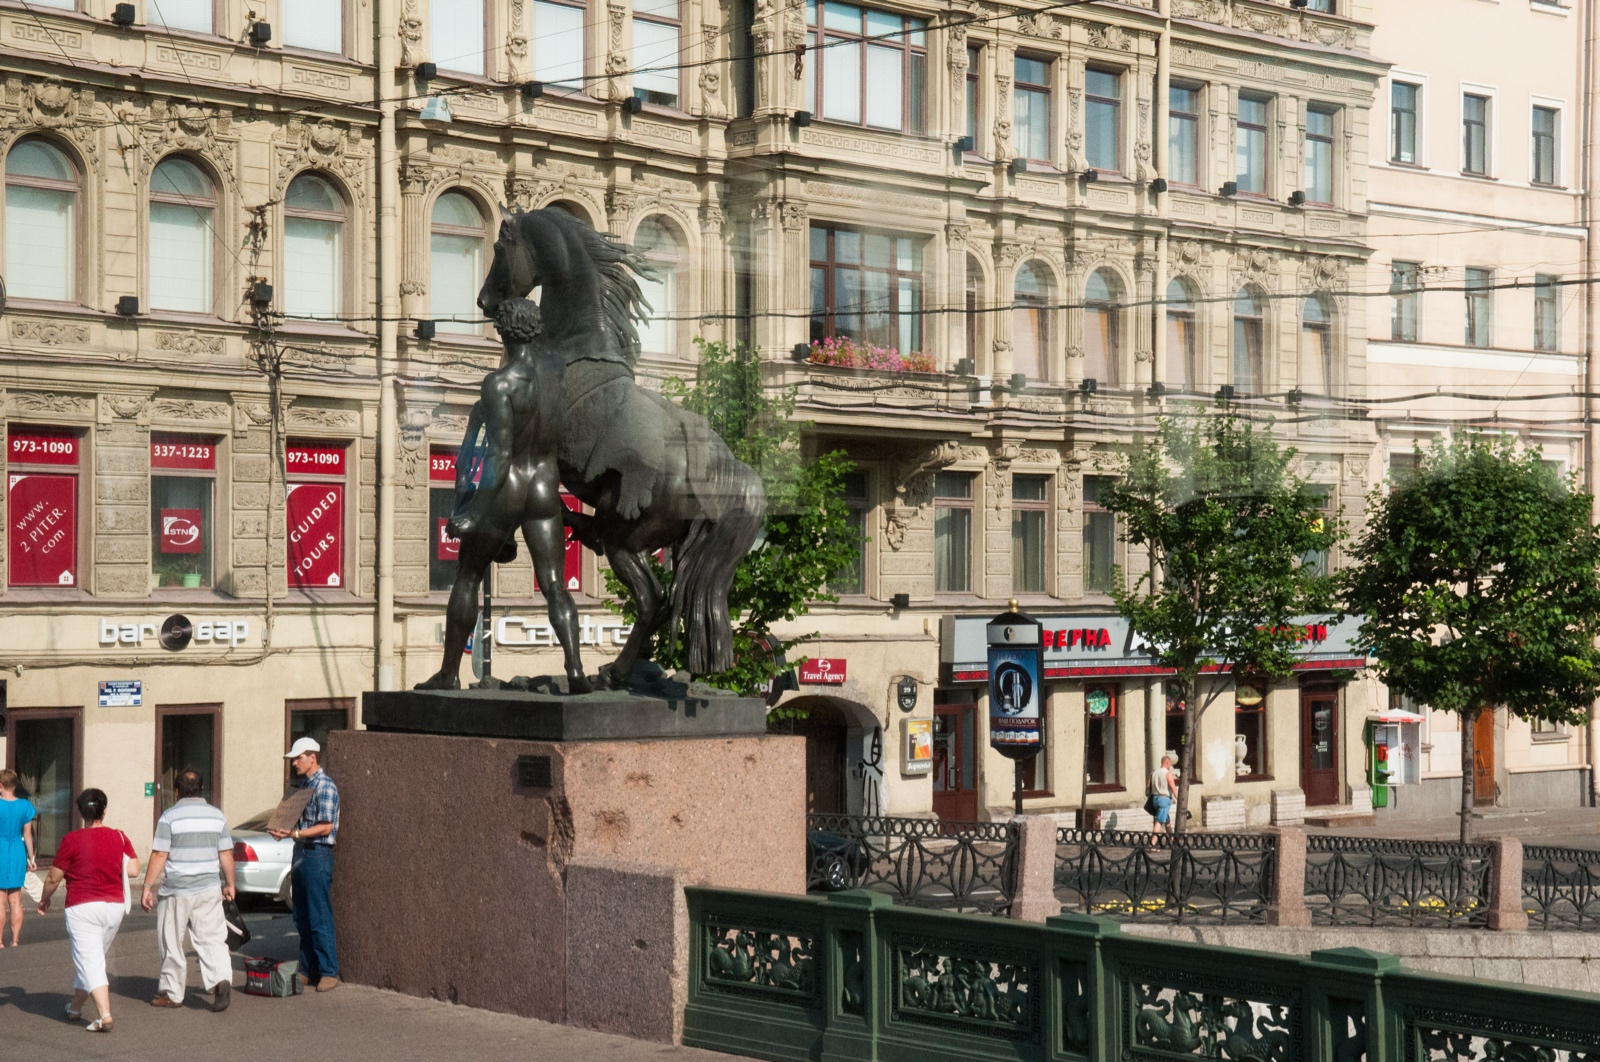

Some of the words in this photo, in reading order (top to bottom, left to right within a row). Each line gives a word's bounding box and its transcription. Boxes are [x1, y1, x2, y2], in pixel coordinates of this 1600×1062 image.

[13, 440, 73, 454] 973-1090
[154, 445, 210, 459] 337-1223
[288, 452, 340, 464] 973-1090
[16, 501, 49, 530] www.
[290, 491, 337, 543] GUIDED
[21, 541, 30, 553] 2
[29, 508, 67, 542] PITER.
[42, 530, 65, 554] com
[294, 532, 335, 577] TOURS
[99, 617, 156, 643] bar
[496, 614, 635, 645] Cetre
[1043, 628, 1112, 648] ВЕРНА
[803, 671, 822, 680] Travel
[823, 671, 845, 682] Agency
